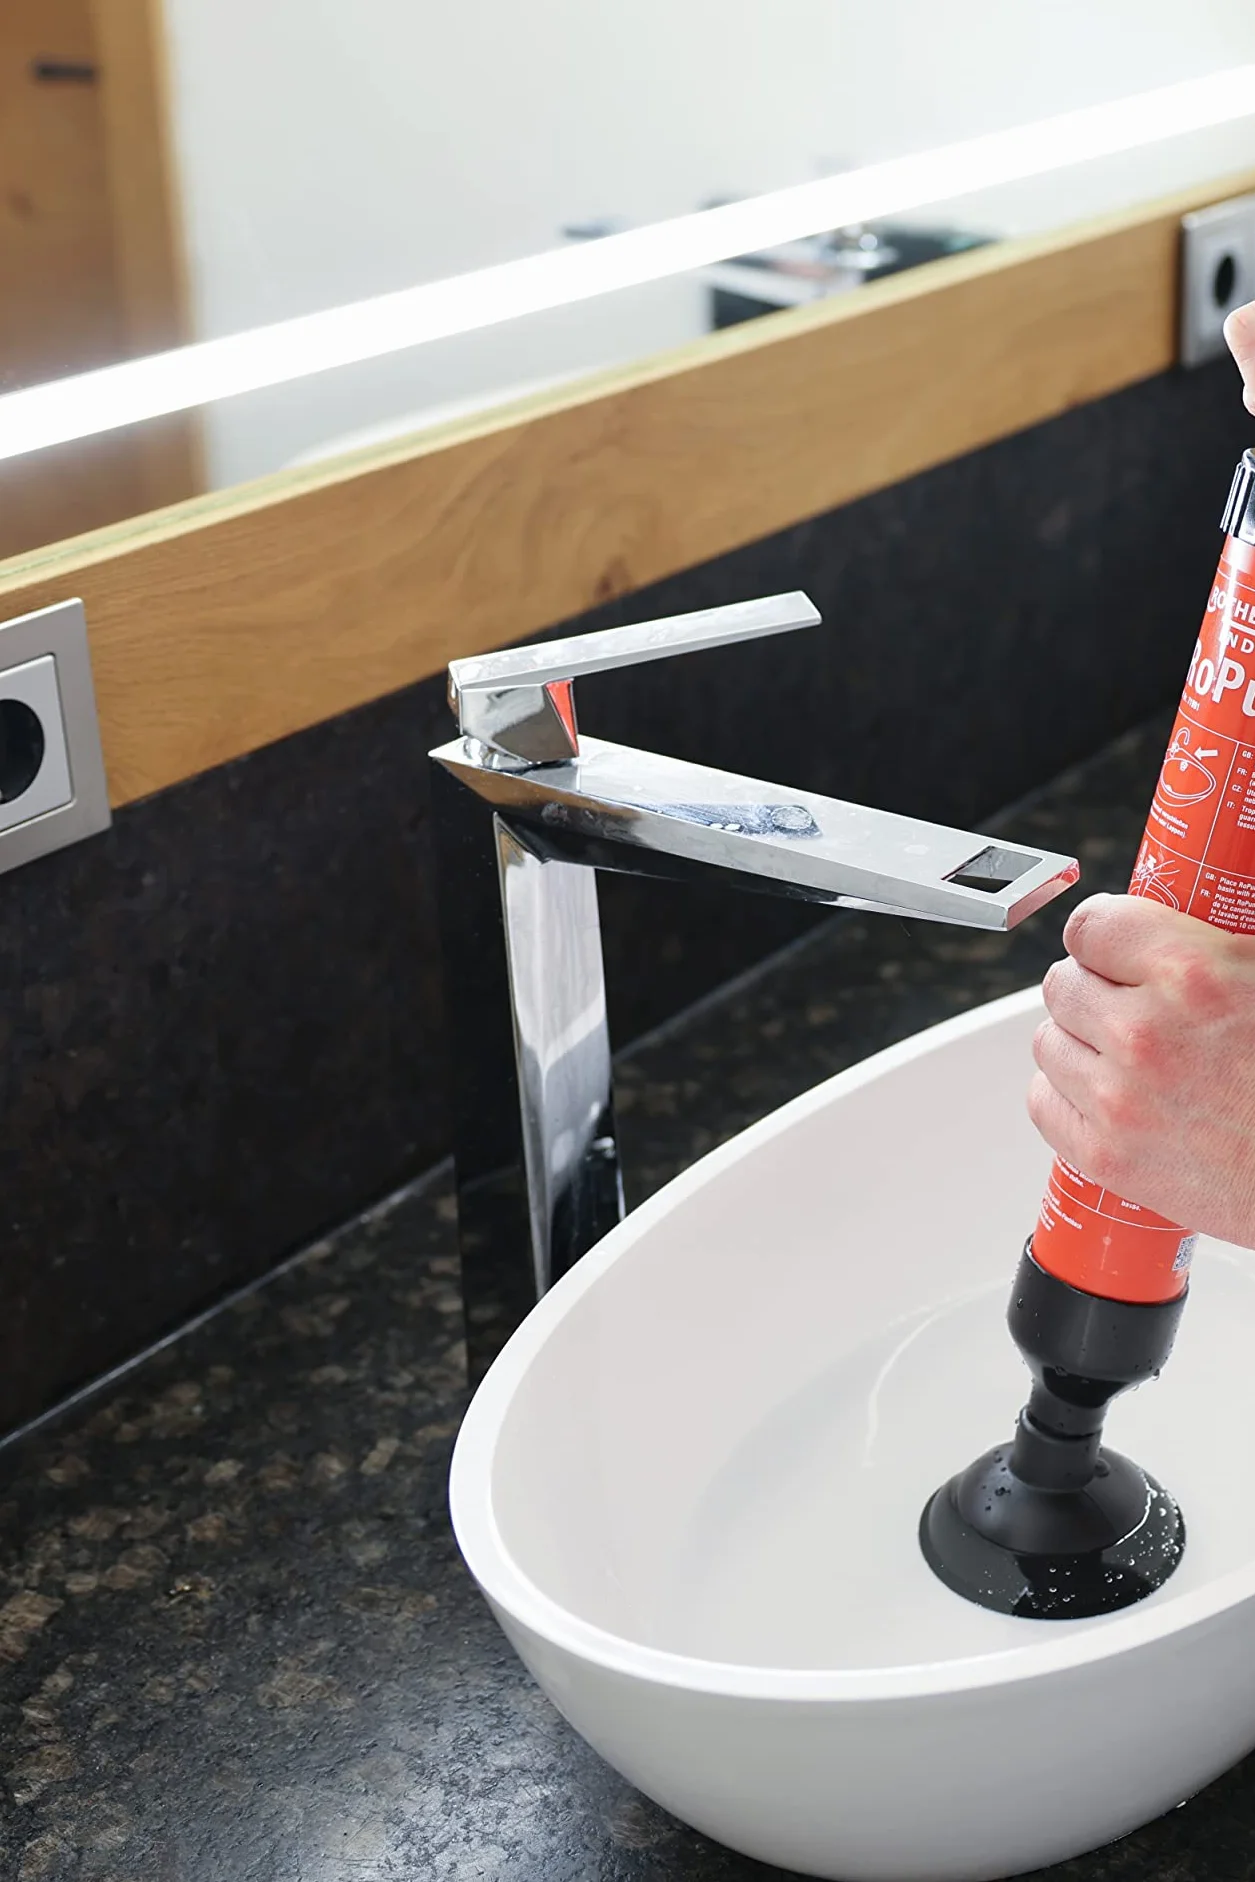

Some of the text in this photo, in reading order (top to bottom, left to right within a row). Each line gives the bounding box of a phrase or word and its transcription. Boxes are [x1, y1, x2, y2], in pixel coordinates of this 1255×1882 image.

[1242, 750, 1254, 759] GB:
[1236, 768, 1248, 776] FR:
[1226, 801, 1236, 809] IT:
[1205, 872, 1216, 880] GB:
[1220, 876, 1238, 886] Place
[1200, 888, 1210, 897] FR:
[1214, 894, 1236, 904] Placez
[1218, 884, 1234, 894] basin
[1236, 888, 1250, 897] with
[1218, 910, 1239, 920] lavabo
[1208, 915, 1238, 928] d'environ
